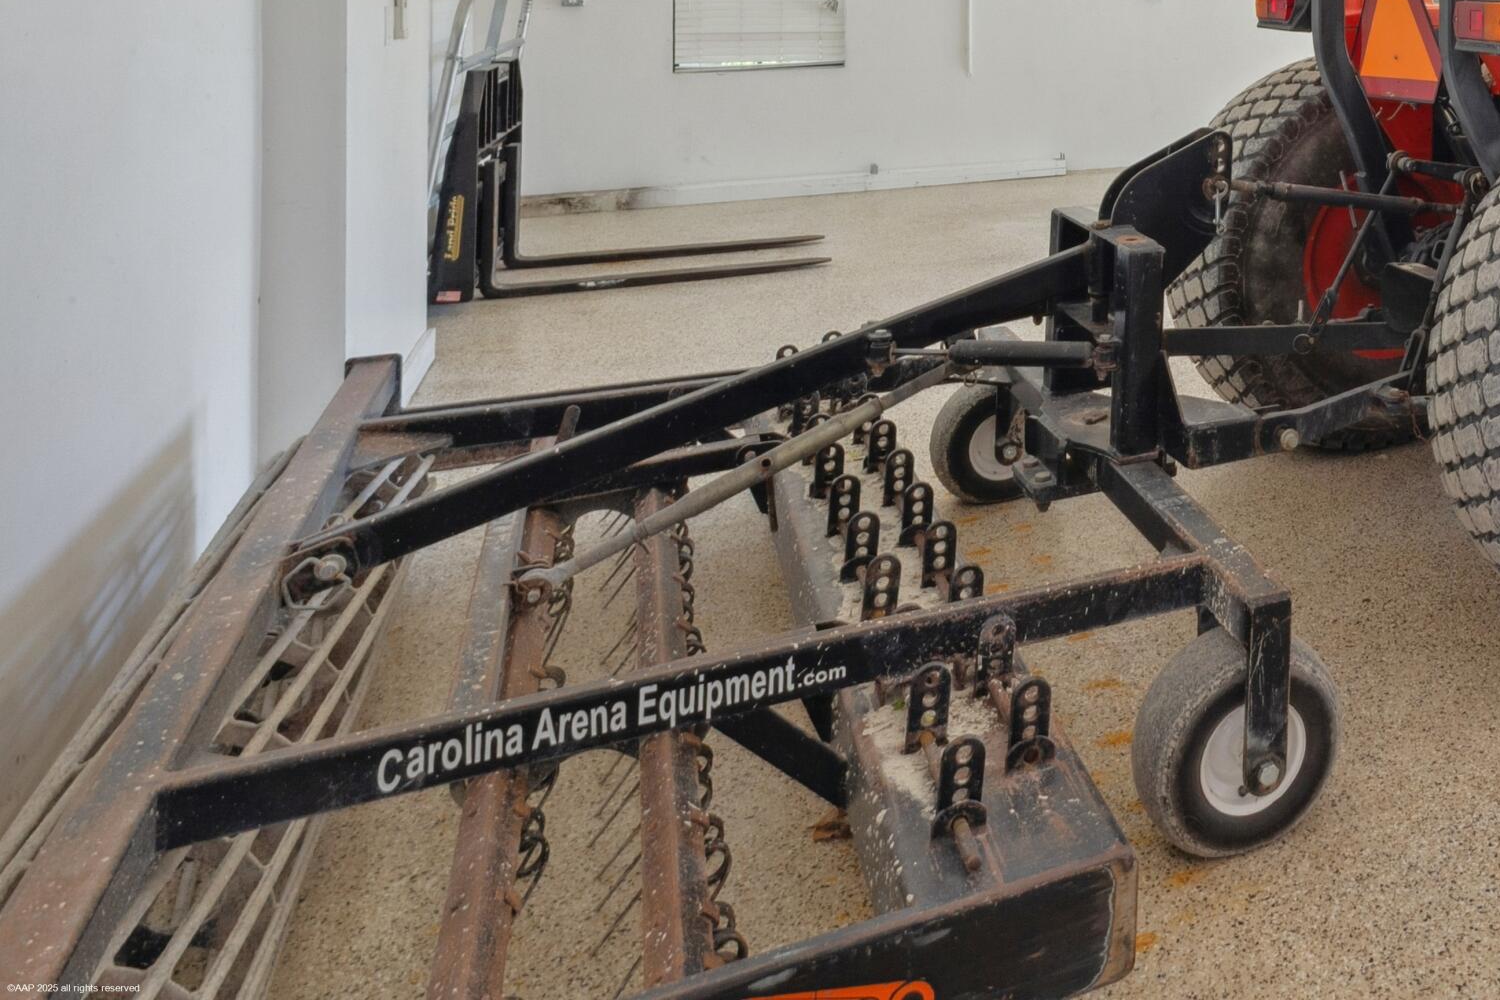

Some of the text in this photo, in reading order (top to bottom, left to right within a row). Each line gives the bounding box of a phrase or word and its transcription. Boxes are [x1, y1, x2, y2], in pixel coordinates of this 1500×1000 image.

[377, 656, 847, 793] Carolina Arena Equipment.com
